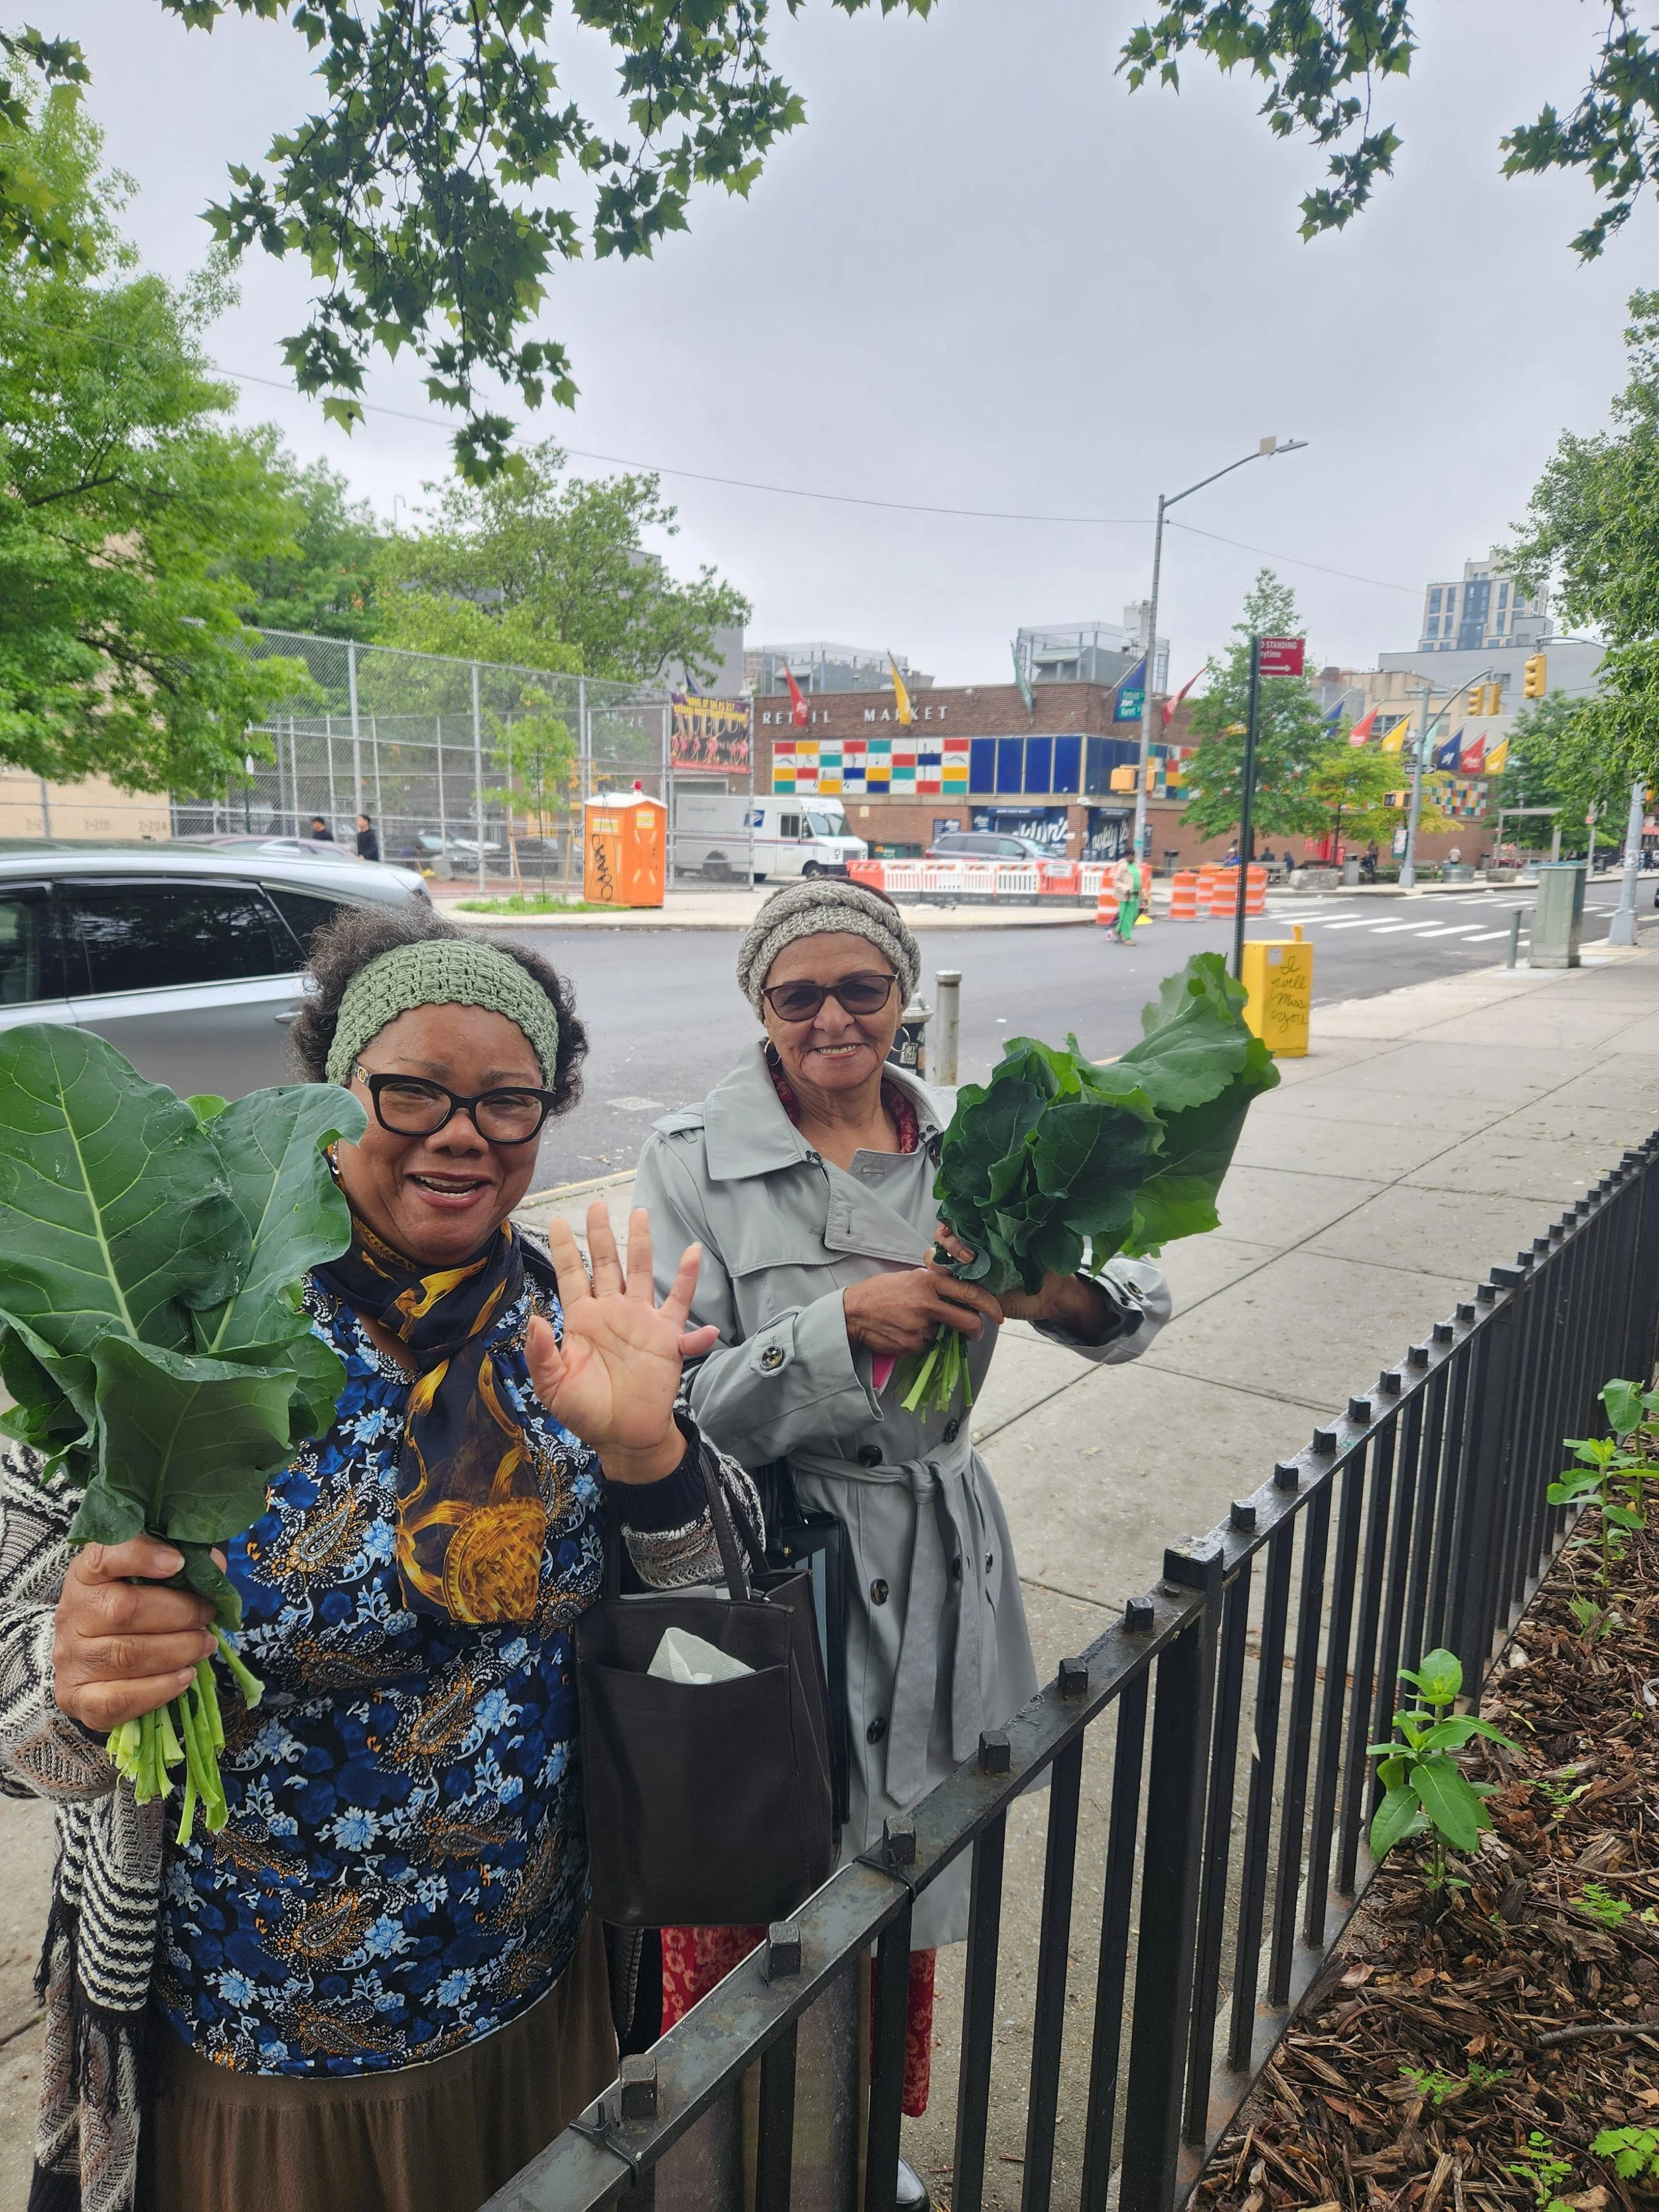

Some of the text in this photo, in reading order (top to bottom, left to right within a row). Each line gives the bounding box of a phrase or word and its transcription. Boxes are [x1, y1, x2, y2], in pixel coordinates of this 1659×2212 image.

[1265, 641, 1297, 650] STANDING
[1260, 650, 1282, 659] nytime
[763, 706, 948, 725] RETIL MAKET
[1121, 707, 1135, 715] Varet
[1271, 975, 1306, 990] will
[1271, 1010, 1309, 1033] you
